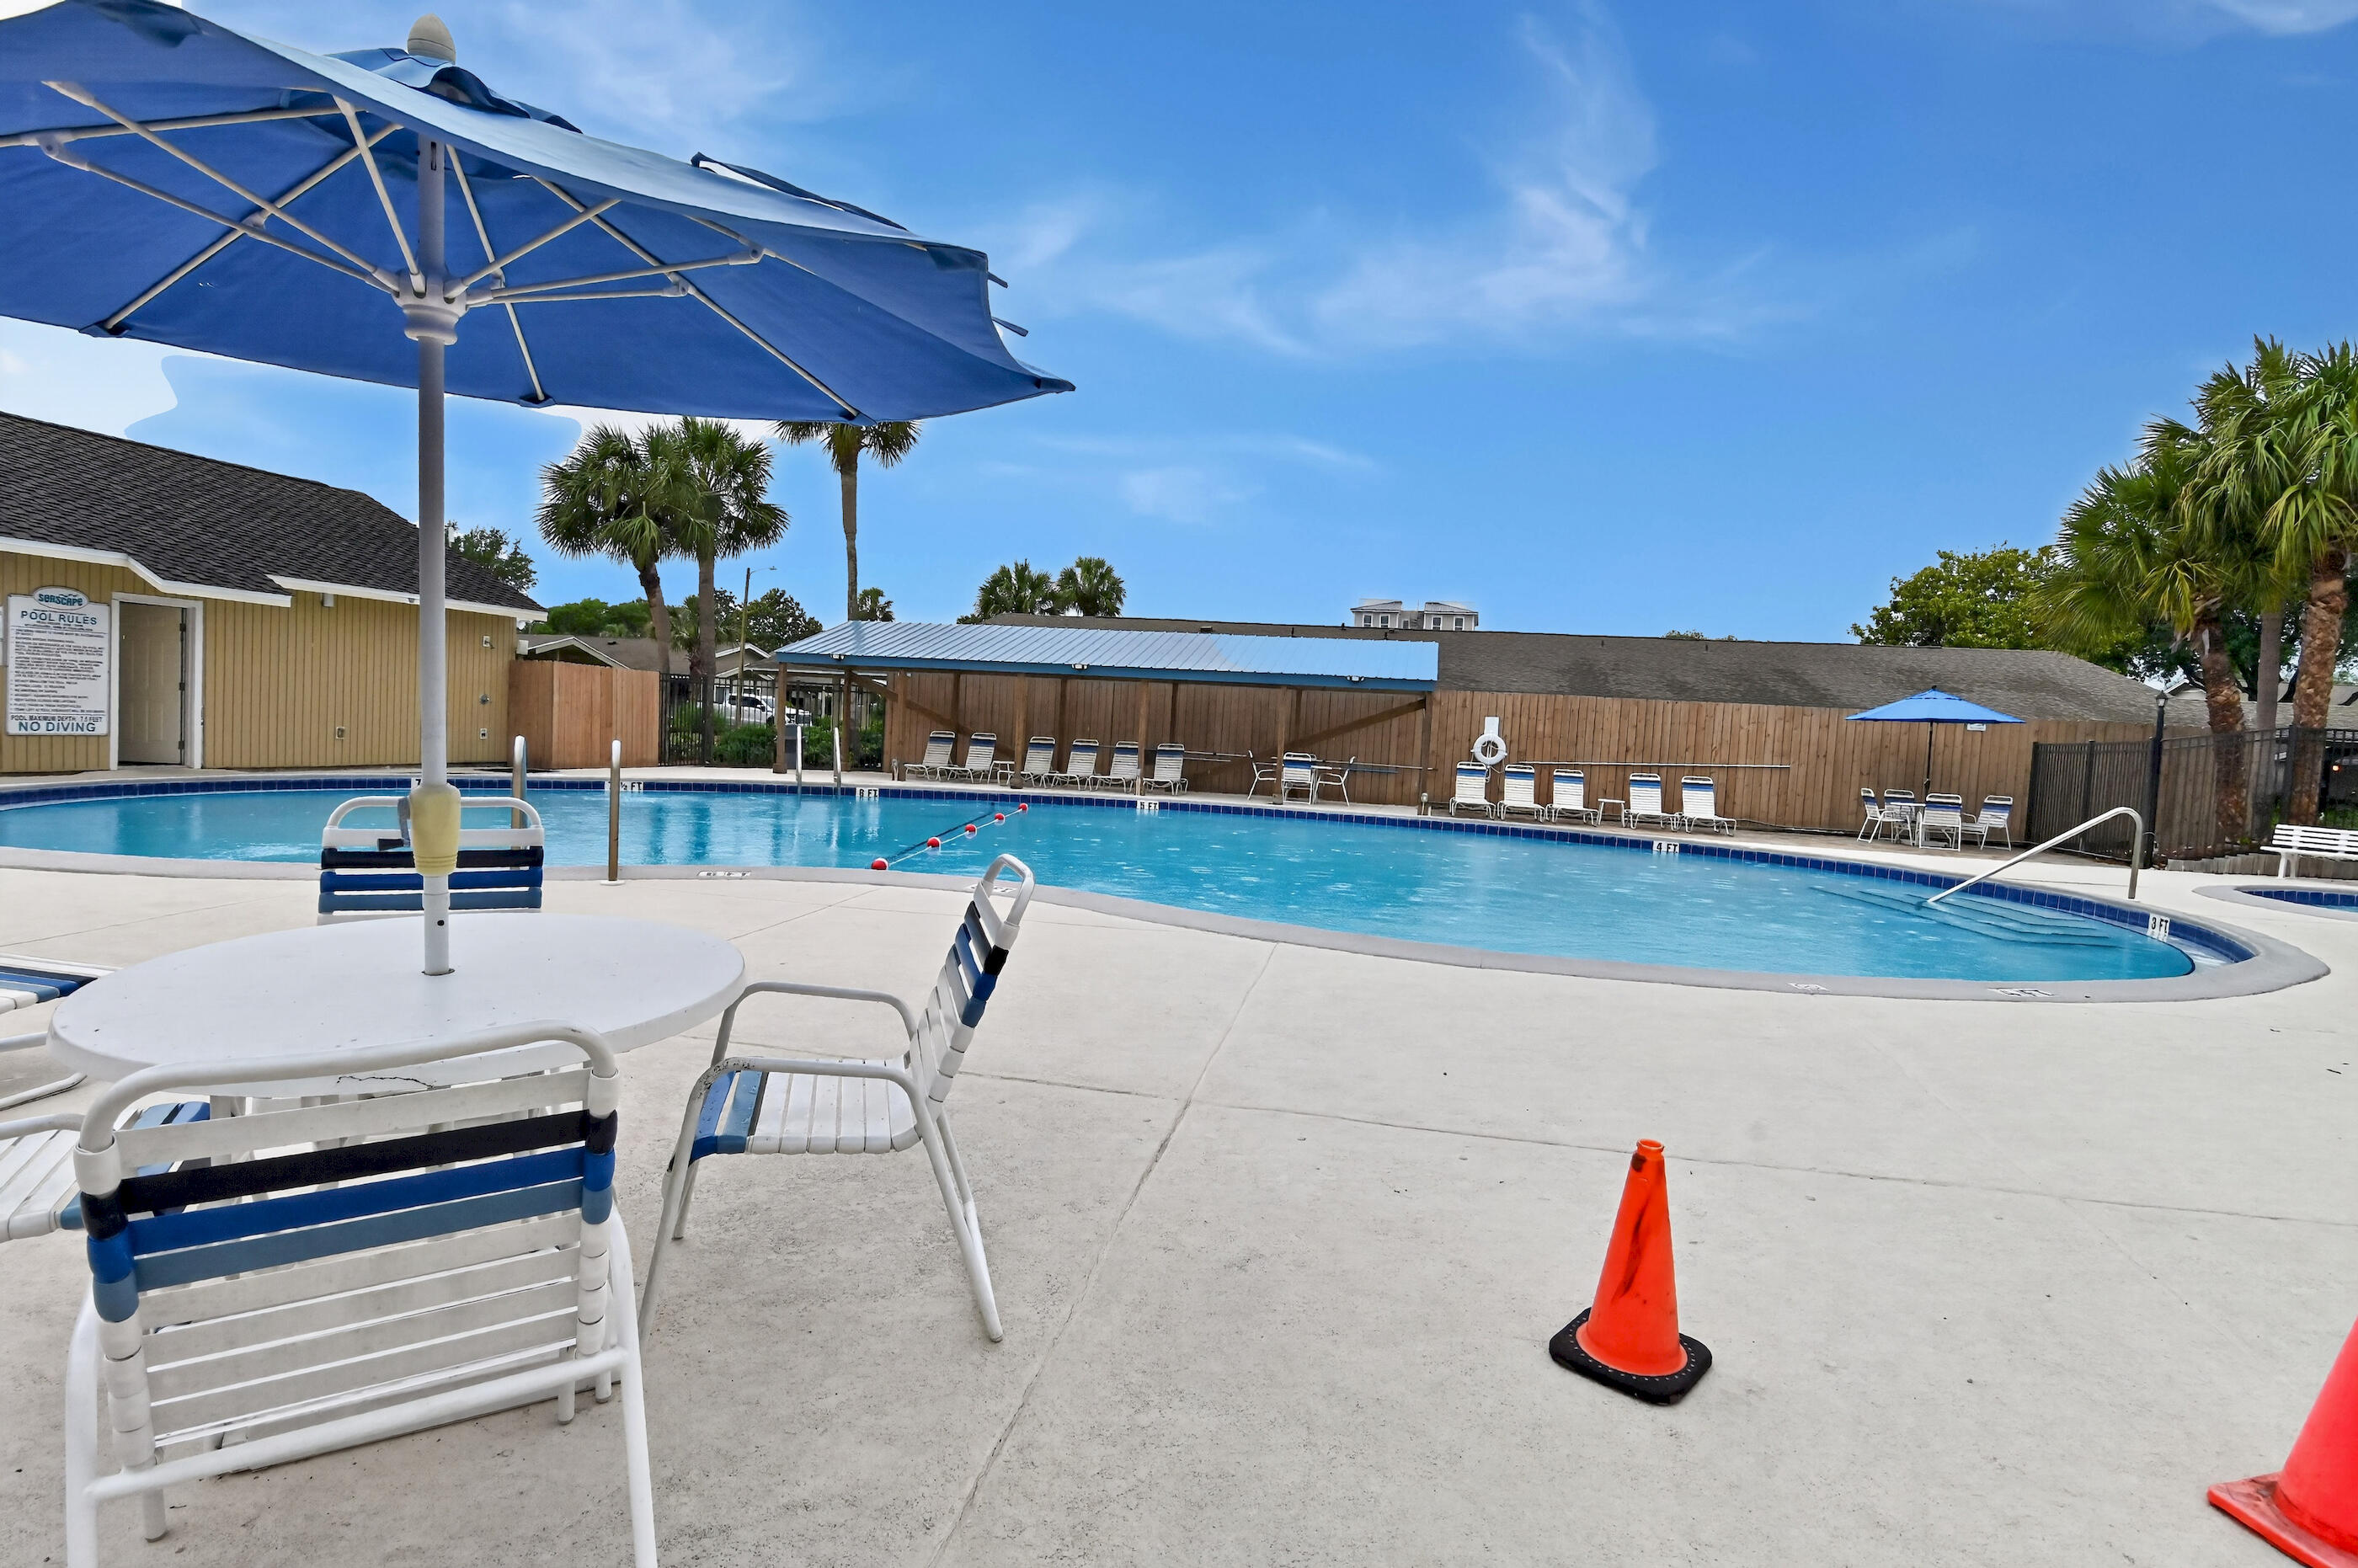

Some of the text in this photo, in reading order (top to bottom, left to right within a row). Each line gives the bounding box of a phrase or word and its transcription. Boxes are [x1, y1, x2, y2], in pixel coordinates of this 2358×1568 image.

[20, 611, 56, 622] POOL
[58, 614, 98, 626] RULES
[19, 721, 97, 732] NO DIVING
[1656, 842, 1663, 853] 4
[2151, 916, 2157, 930] 3
